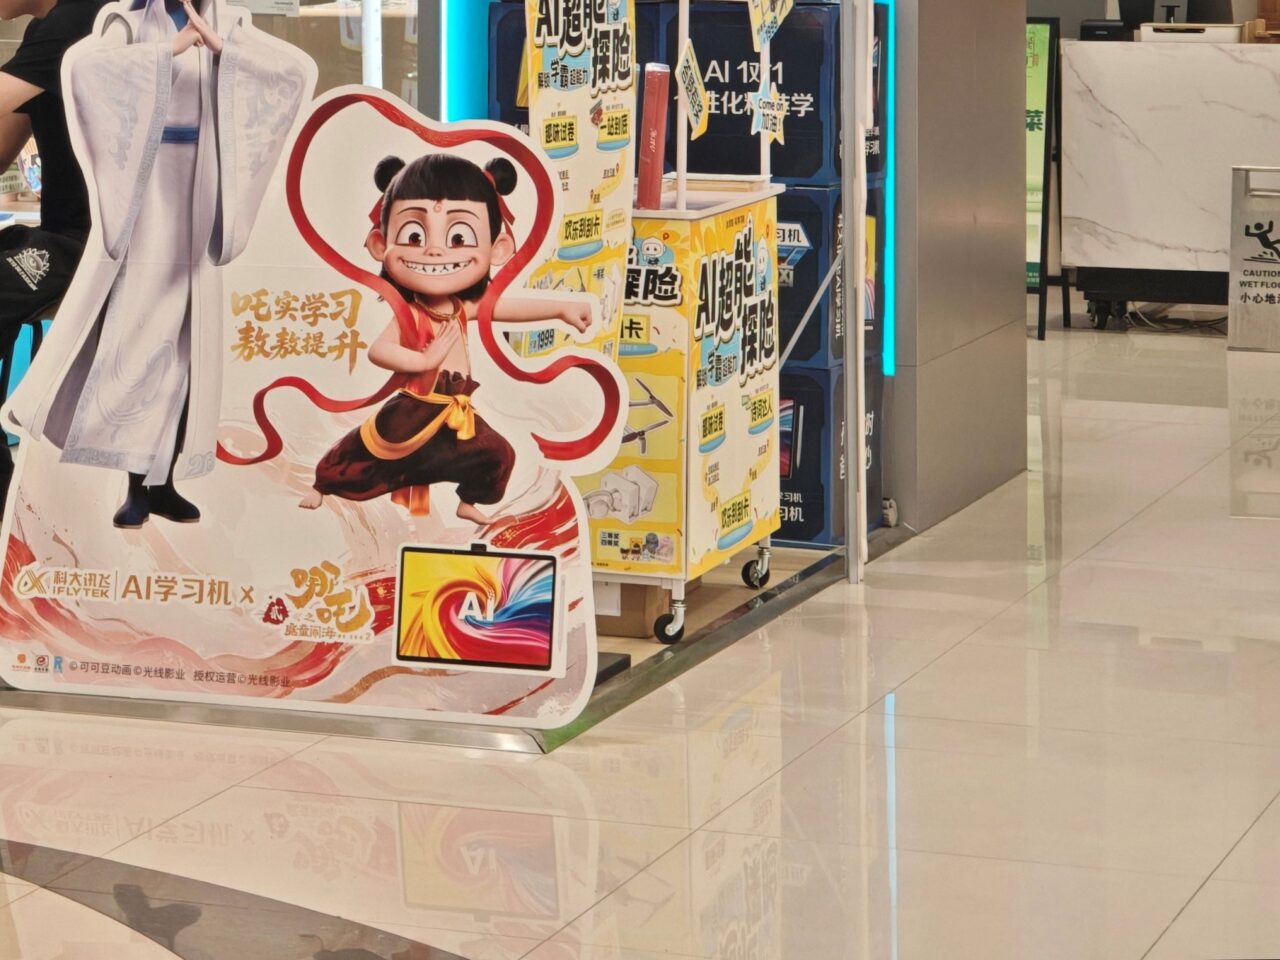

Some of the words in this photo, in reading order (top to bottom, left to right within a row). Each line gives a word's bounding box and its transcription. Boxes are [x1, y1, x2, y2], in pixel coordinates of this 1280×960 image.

[592, 22, 631, 89] 探险
[704, 60, 729, 83] AI
[565, 214, 600, 241] 欢乐刮刮卡
[696, 226, 754, 338] AI超能
[231, 288, 362, 328] 吒实学习
[230, 320, 368, 376] 敖敖提升
[740, 289, 774, 376] 探险
[53, 571, 111, 588] 科大讯飞
[121, 574, 232, 606] AI学习机
[70, 660, 185, 681] ©可可豆动画©光线影业
[193, 671, 290, 688] 授权运营©光线影业
